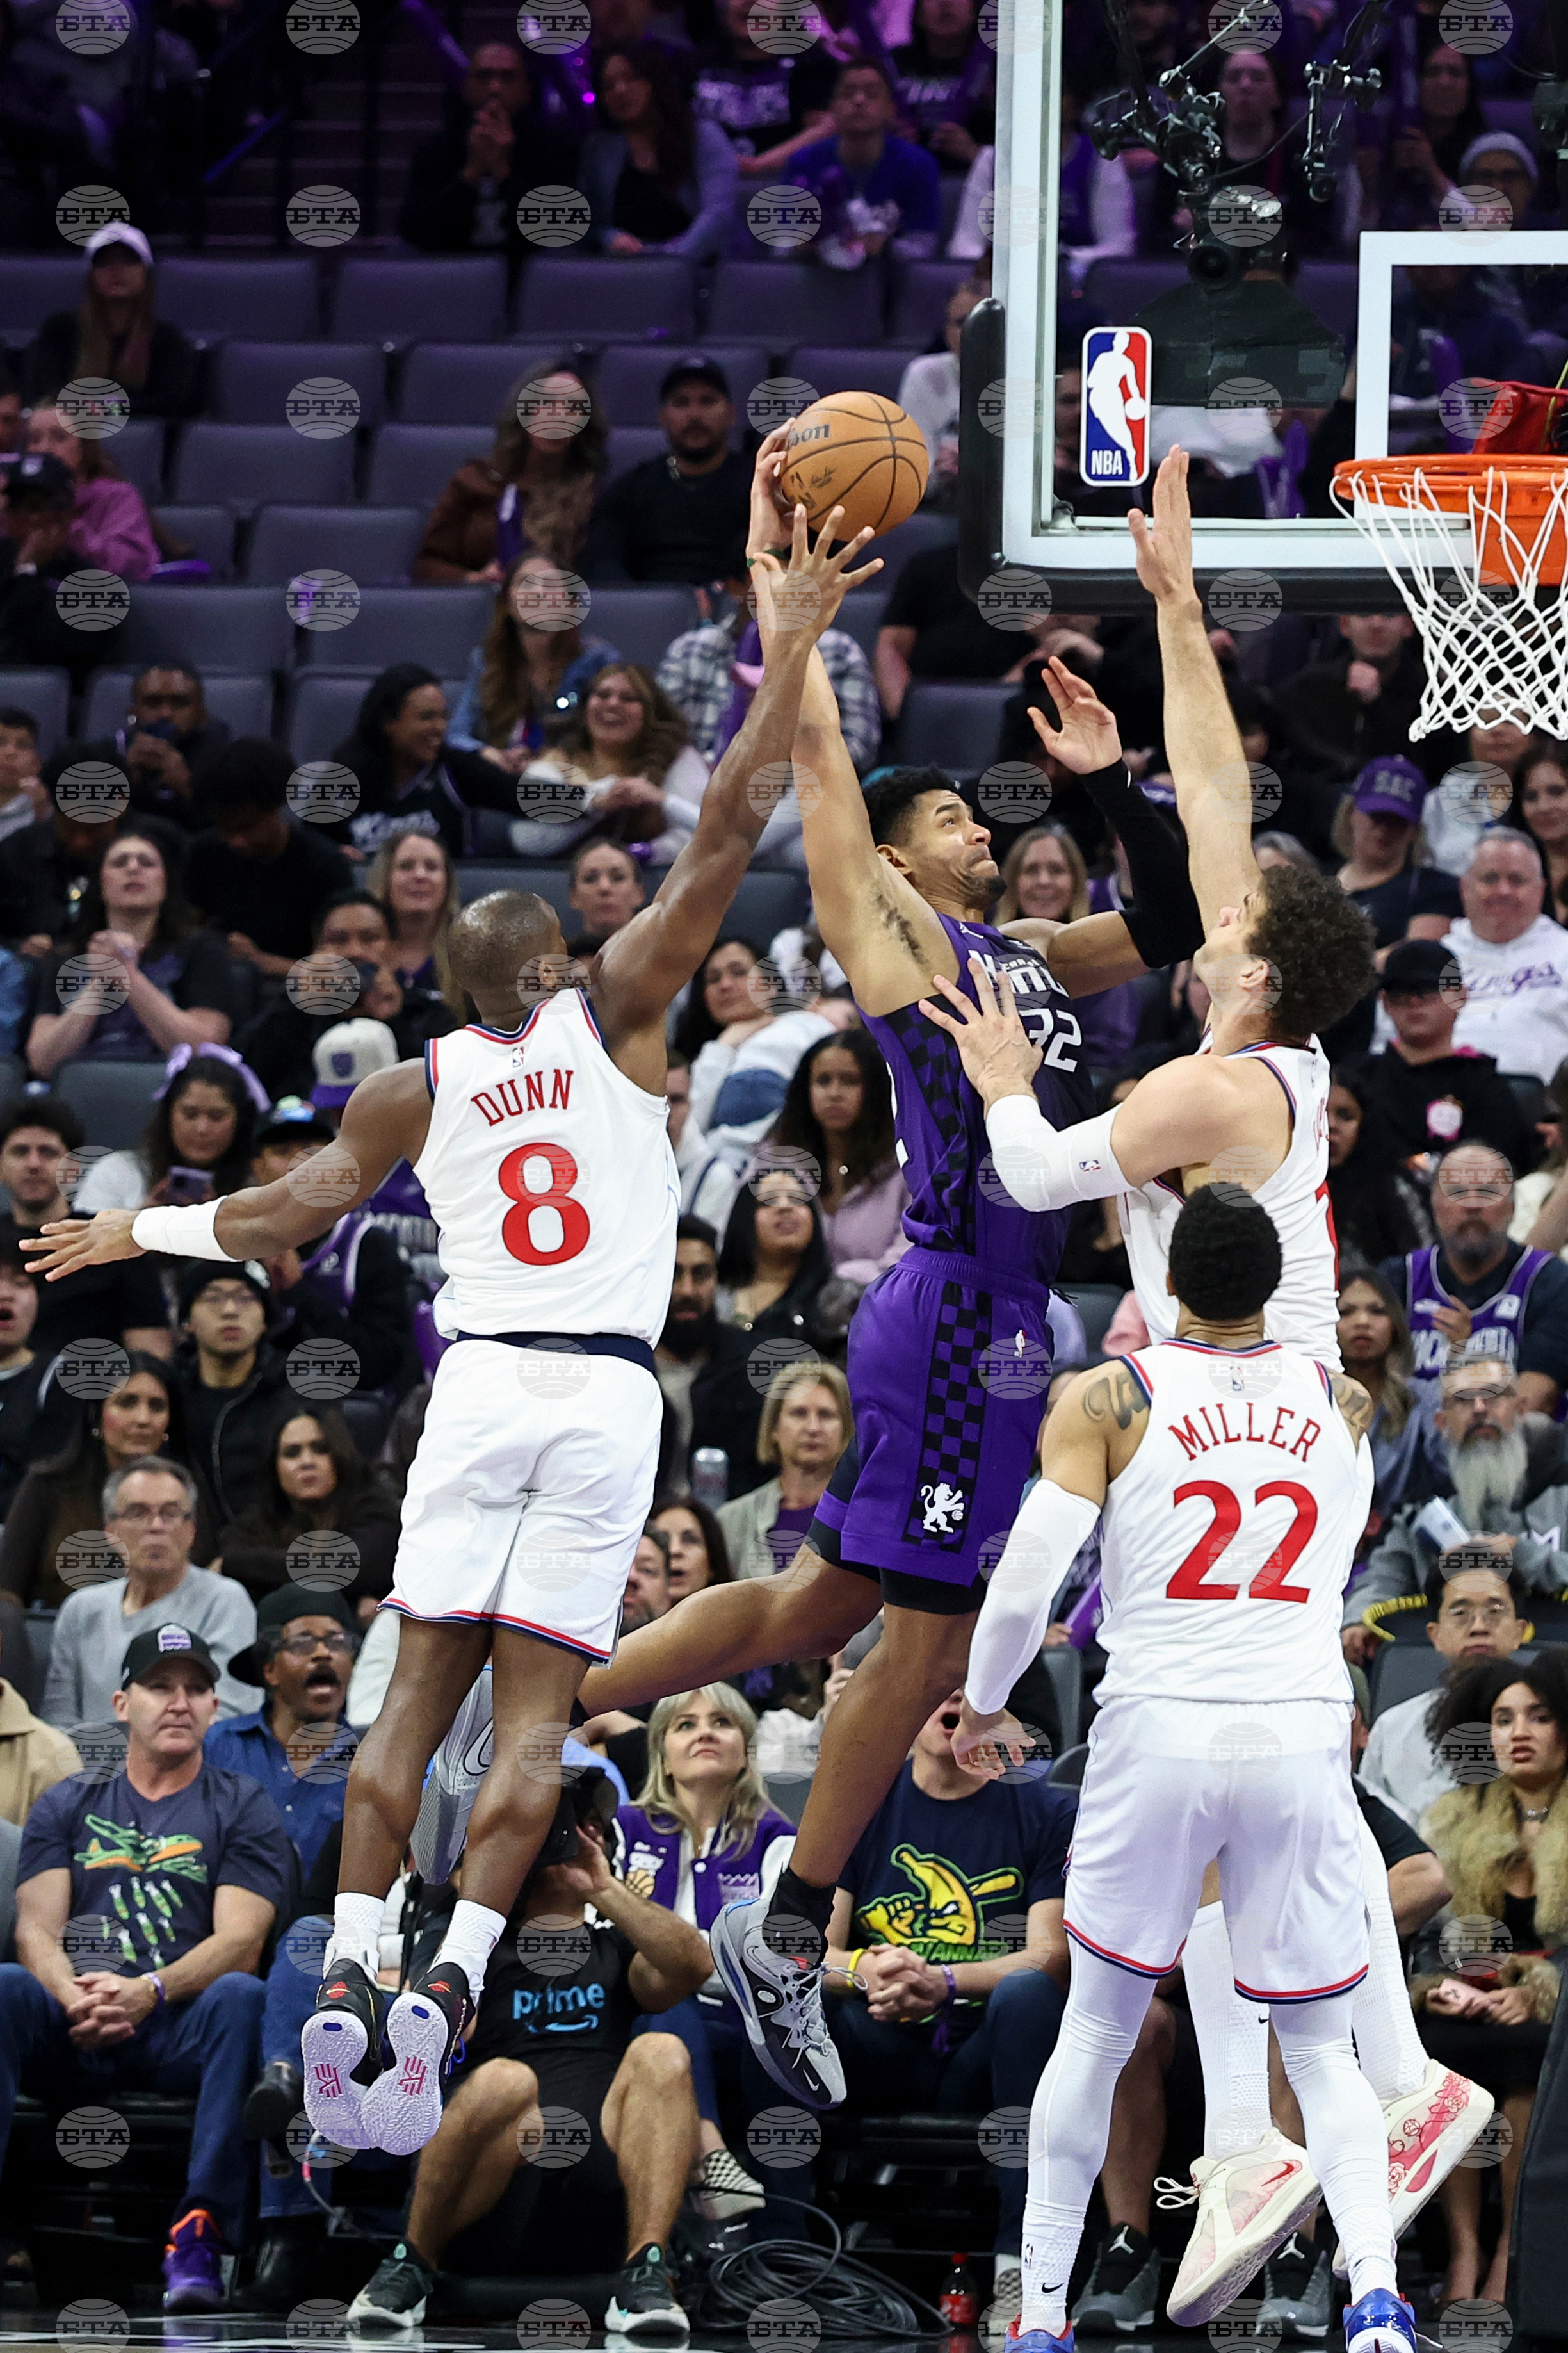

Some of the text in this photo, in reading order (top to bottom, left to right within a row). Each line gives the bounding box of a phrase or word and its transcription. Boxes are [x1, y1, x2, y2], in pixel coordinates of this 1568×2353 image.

[1091, 450, 1123, 475] NBA
[1019, 1007, 1082, 1073] 32
[471, 1069, 574, 1127] DUNN
[498, 1142, 590, 1266] 8
[1167, 1402, 1321, 1463] MILLER
[1166, 1480, 1318, 1603] 22
[512, 1982, 606, 2020] prime
